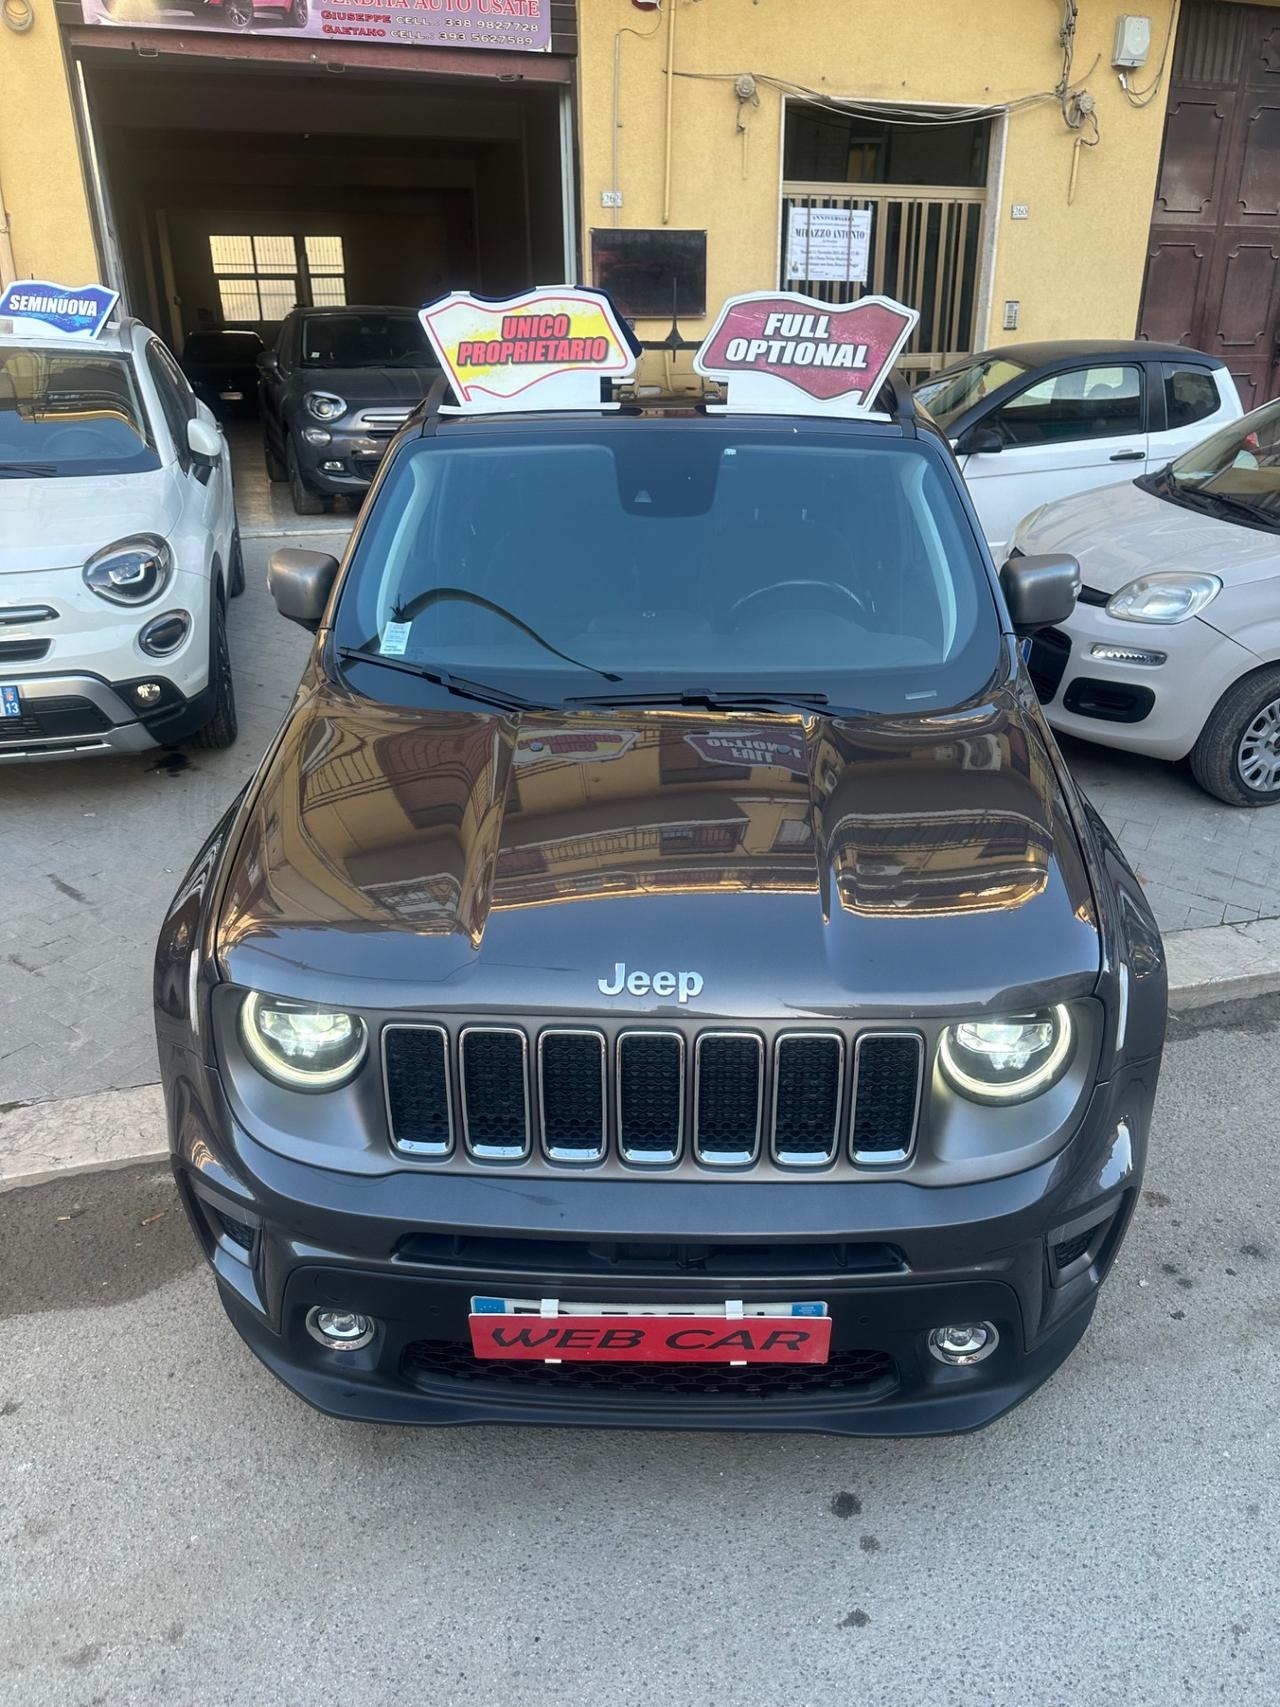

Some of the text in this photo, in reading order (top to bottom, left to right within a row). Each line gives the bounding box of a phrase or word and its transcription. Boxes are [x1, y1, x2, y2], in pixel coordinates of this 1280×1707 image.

[477, 0, 540, 17] USATE
[321, 10, 391, 23] GIUSEPPE
[446, 18, 471, 27] 338
[477, 20, 538, 32] 9827728
[322, 24, 386, 37] GAETANO
[439, 32, 466, 41] 393
[471, 33, 533, 45] 5627589
[8, 294, 98, 317] SEMINUOVA
[501, 313, 571, 339] UNICO
[763, 312, 830, 339] FULL
[457, 337, 609, 366] PROPRIETARIO
[725, 337, 868, 368] OPTIONAL
[5, 702, 20, 714] 13
[598, 962, 704, 1003] Jeep
[491, 1328, 811, 1351] WEB CAR
